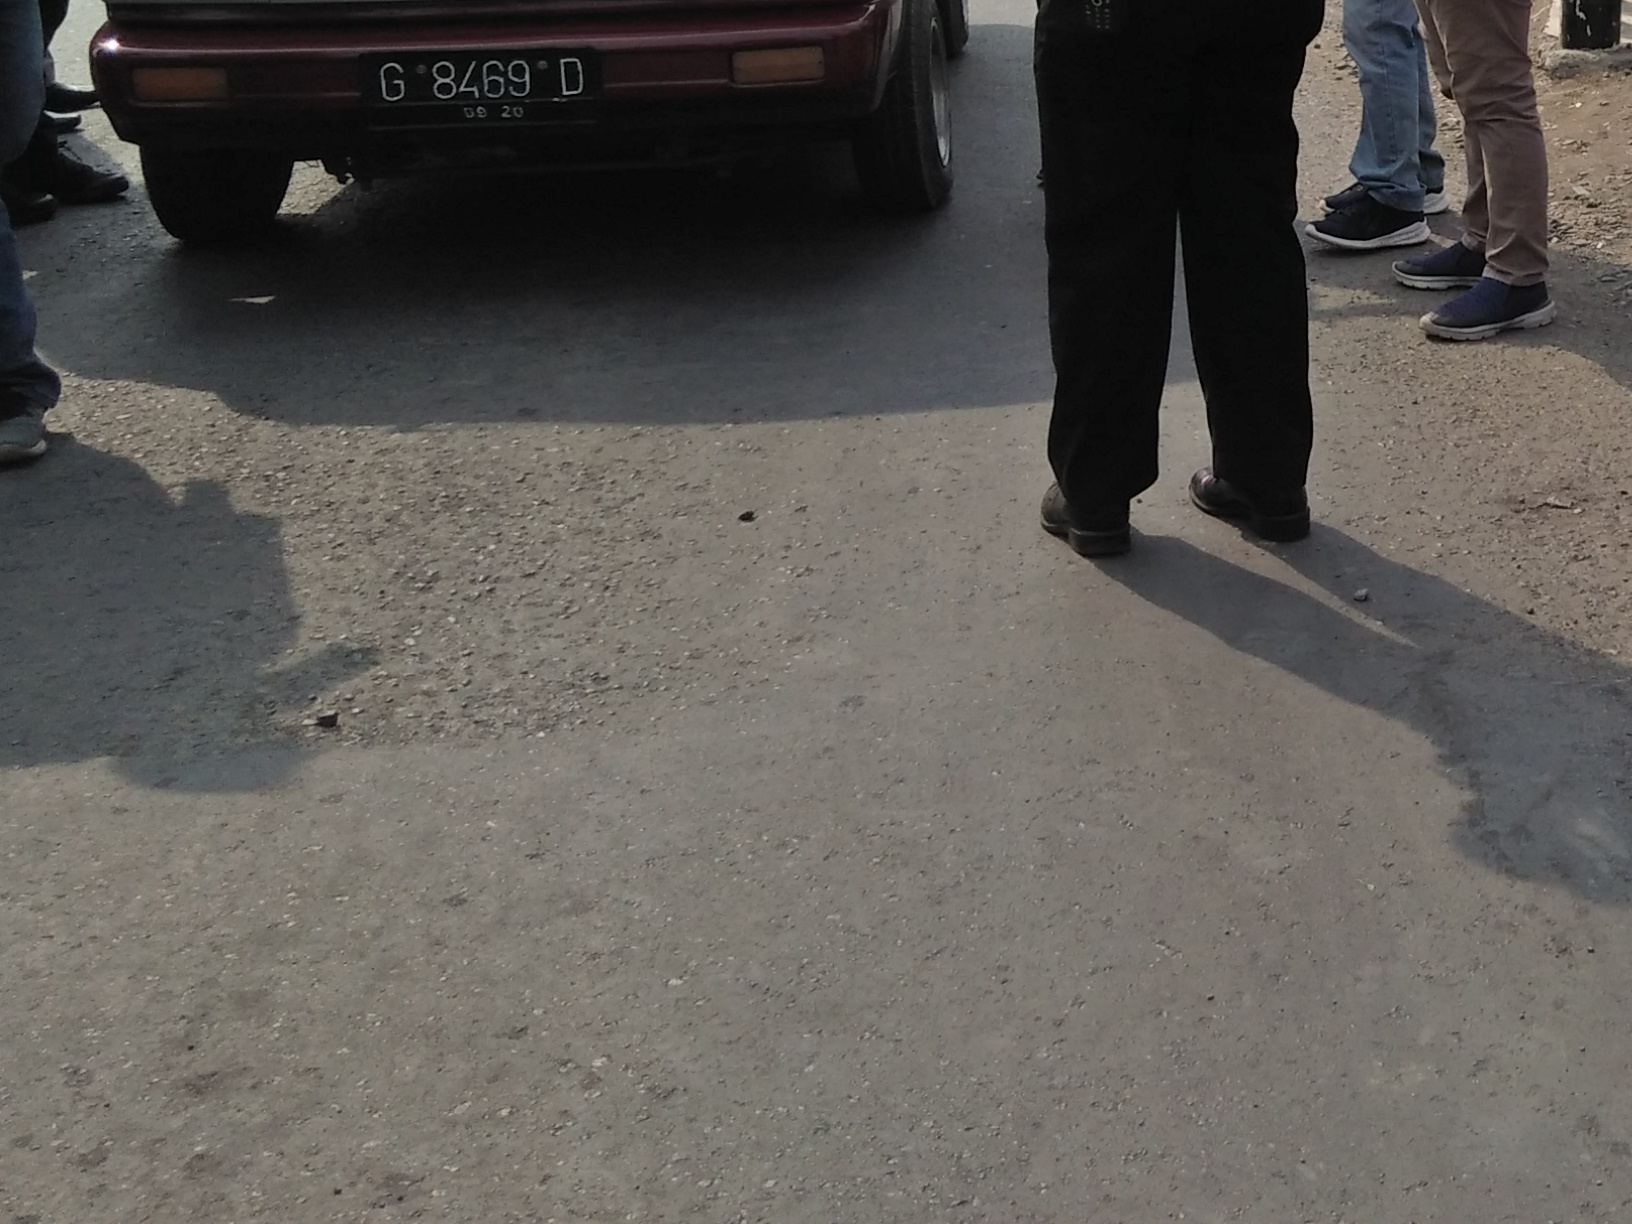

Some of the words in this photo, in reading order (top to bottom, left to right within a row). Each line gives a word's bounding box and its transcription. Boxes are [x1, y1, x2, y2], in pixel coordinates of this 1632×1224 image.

[380, 62, 405, 101] G
[431, 59, 531, 99] 8469
[559, 57, 584, 95] D
[500, 105, 524, 118] 20
